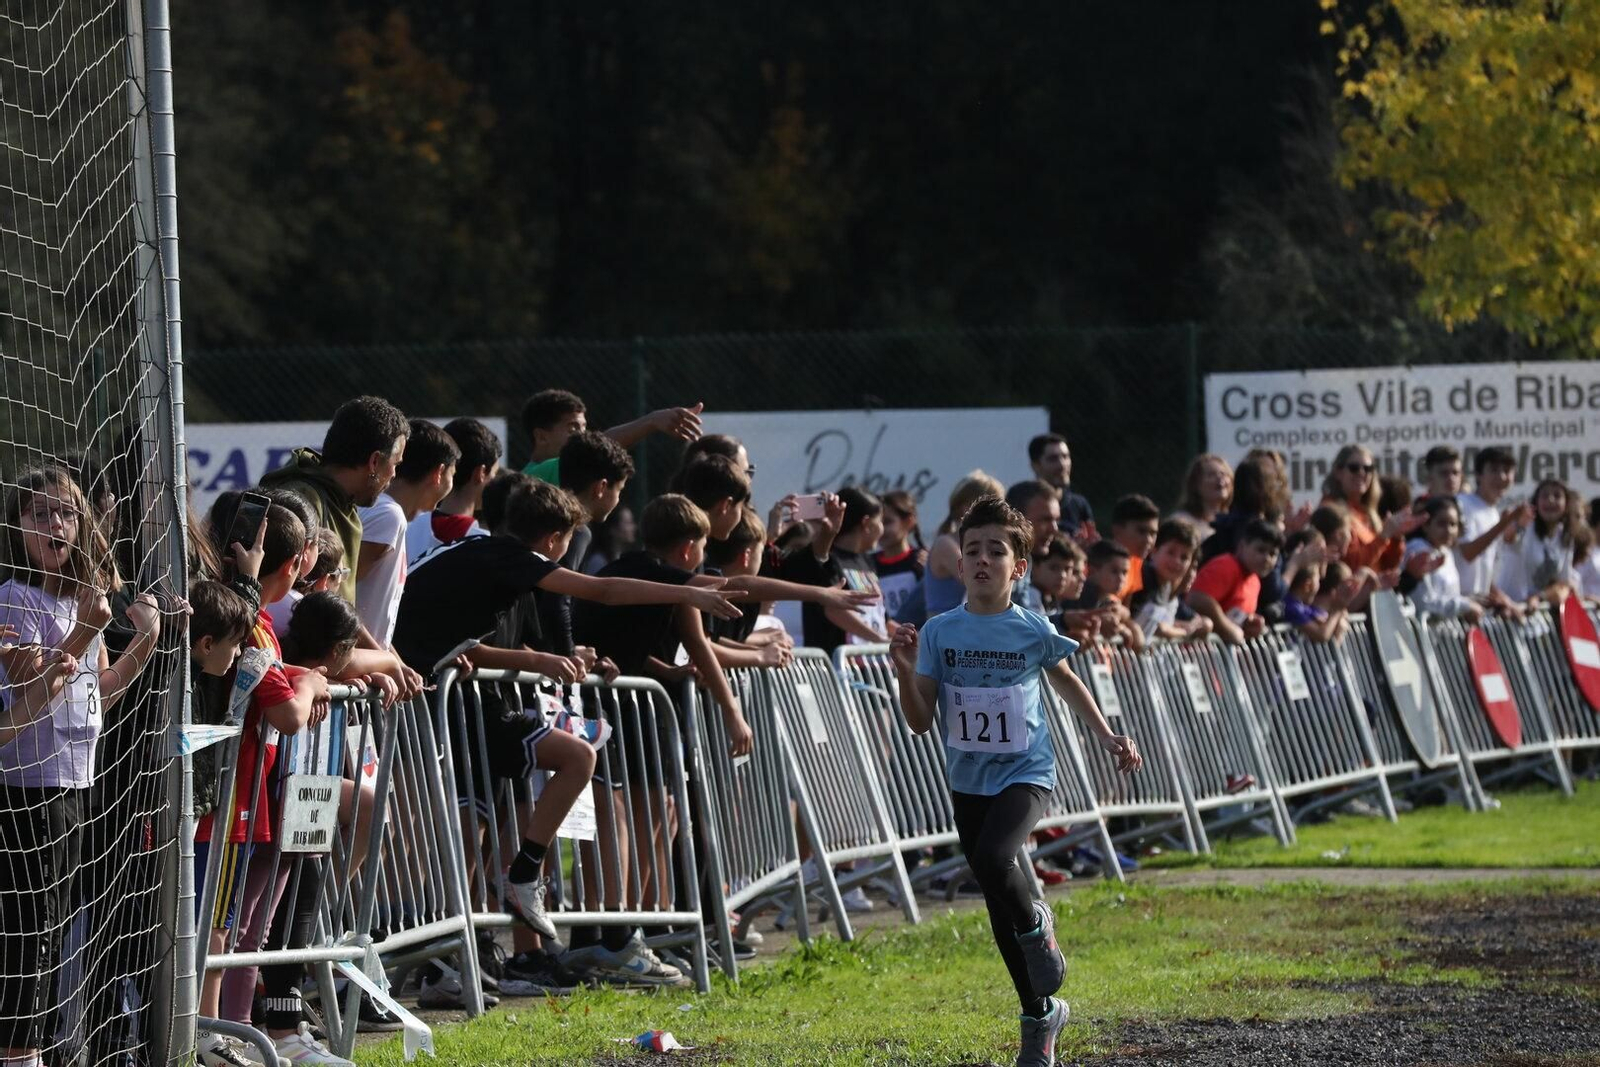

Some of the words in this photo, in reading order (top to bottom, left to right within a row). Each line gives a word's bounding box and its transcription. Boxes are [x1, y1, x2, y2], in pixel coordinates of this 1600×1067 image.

[1221, 385, 1342, 421] Cross
[1357, 379, 1433, 415] Vila
[1449, 378, 1499, 413] de
[1235, 426, 1347, 447] Complexo
[1355, 420, 1466, 445] Deportivo
[1474, 416, 1585, 441] Municipal
[964, 650, 1026, 661] CARREIRA
[957, 658, 987, 669] PEDESTRE
[958, 711, 1011, 743] 121
[298, 787, 332, 802] CONCELLO
[310, 809, 319, 823] DE
[266, 997, 302, 1012] PUMA
